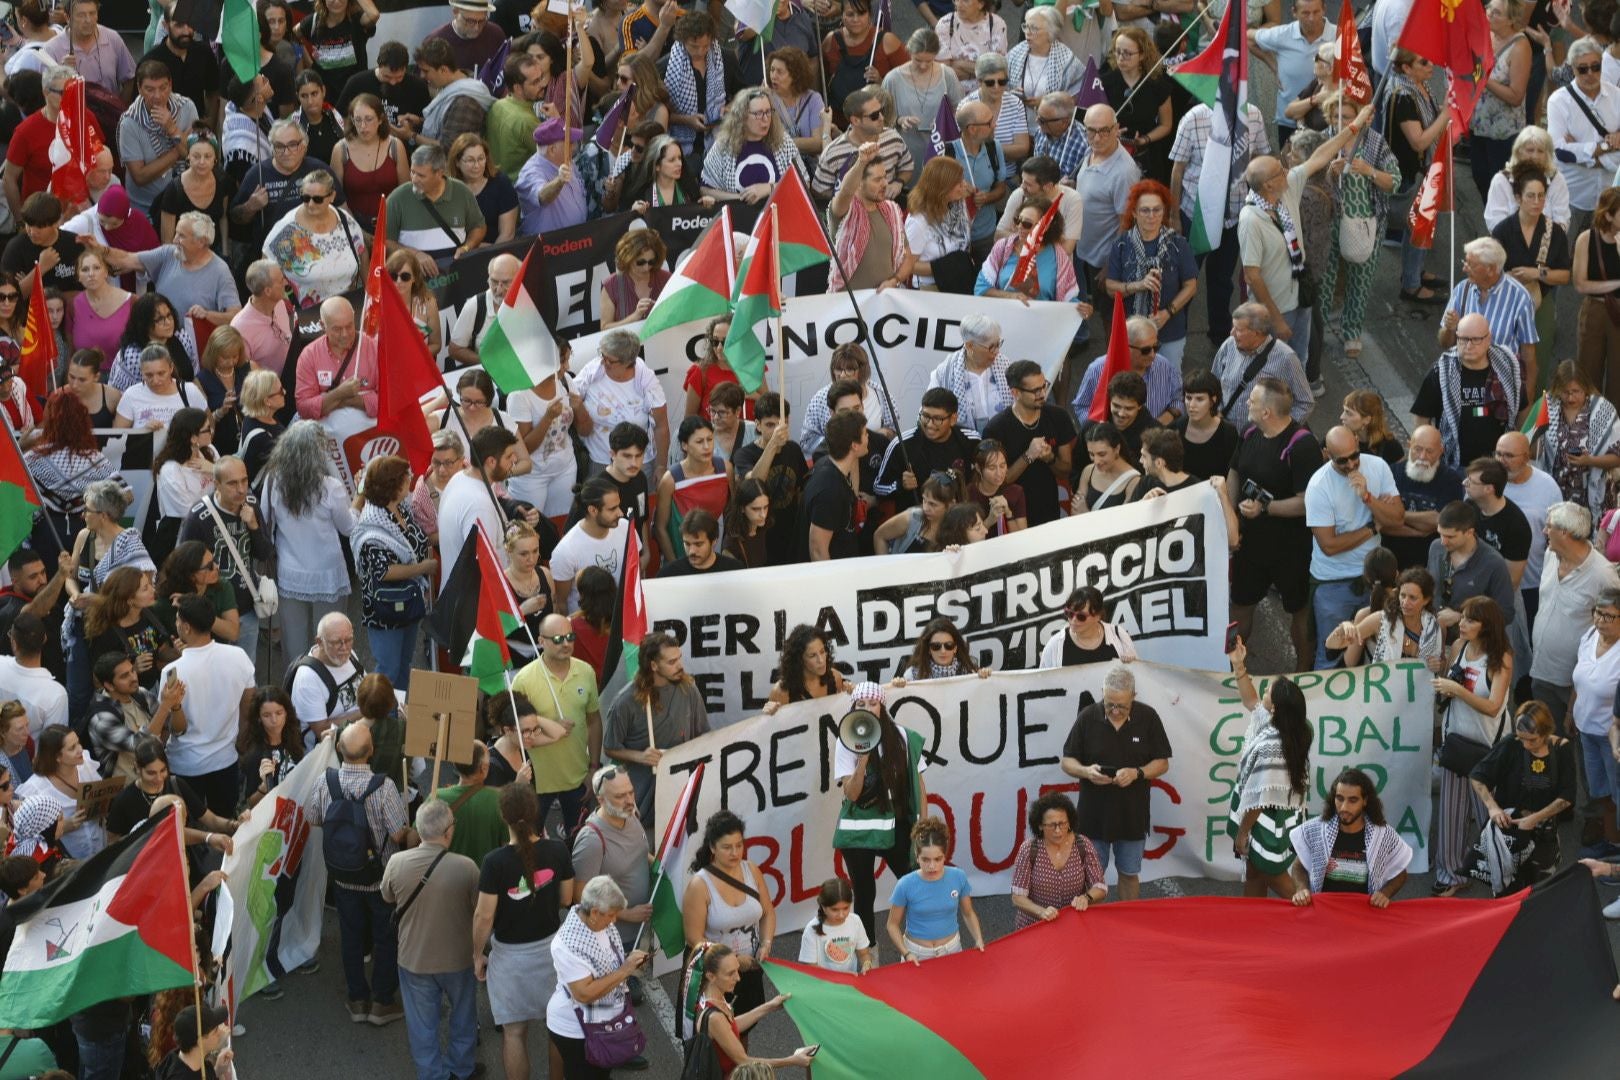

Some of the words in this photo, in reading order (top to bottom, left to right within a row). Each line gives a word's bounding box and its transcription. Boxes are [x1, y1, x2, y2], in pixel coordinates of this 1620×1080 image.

[543, 237, 592, 256] Podem
[653, 613, 761, 658] PER
[862, 517, 1196, 646] DESTRUCCIÓ
[669, 687, 1097, 816] TRENQUE
[1209, 712, 1421, 758] GBAL
